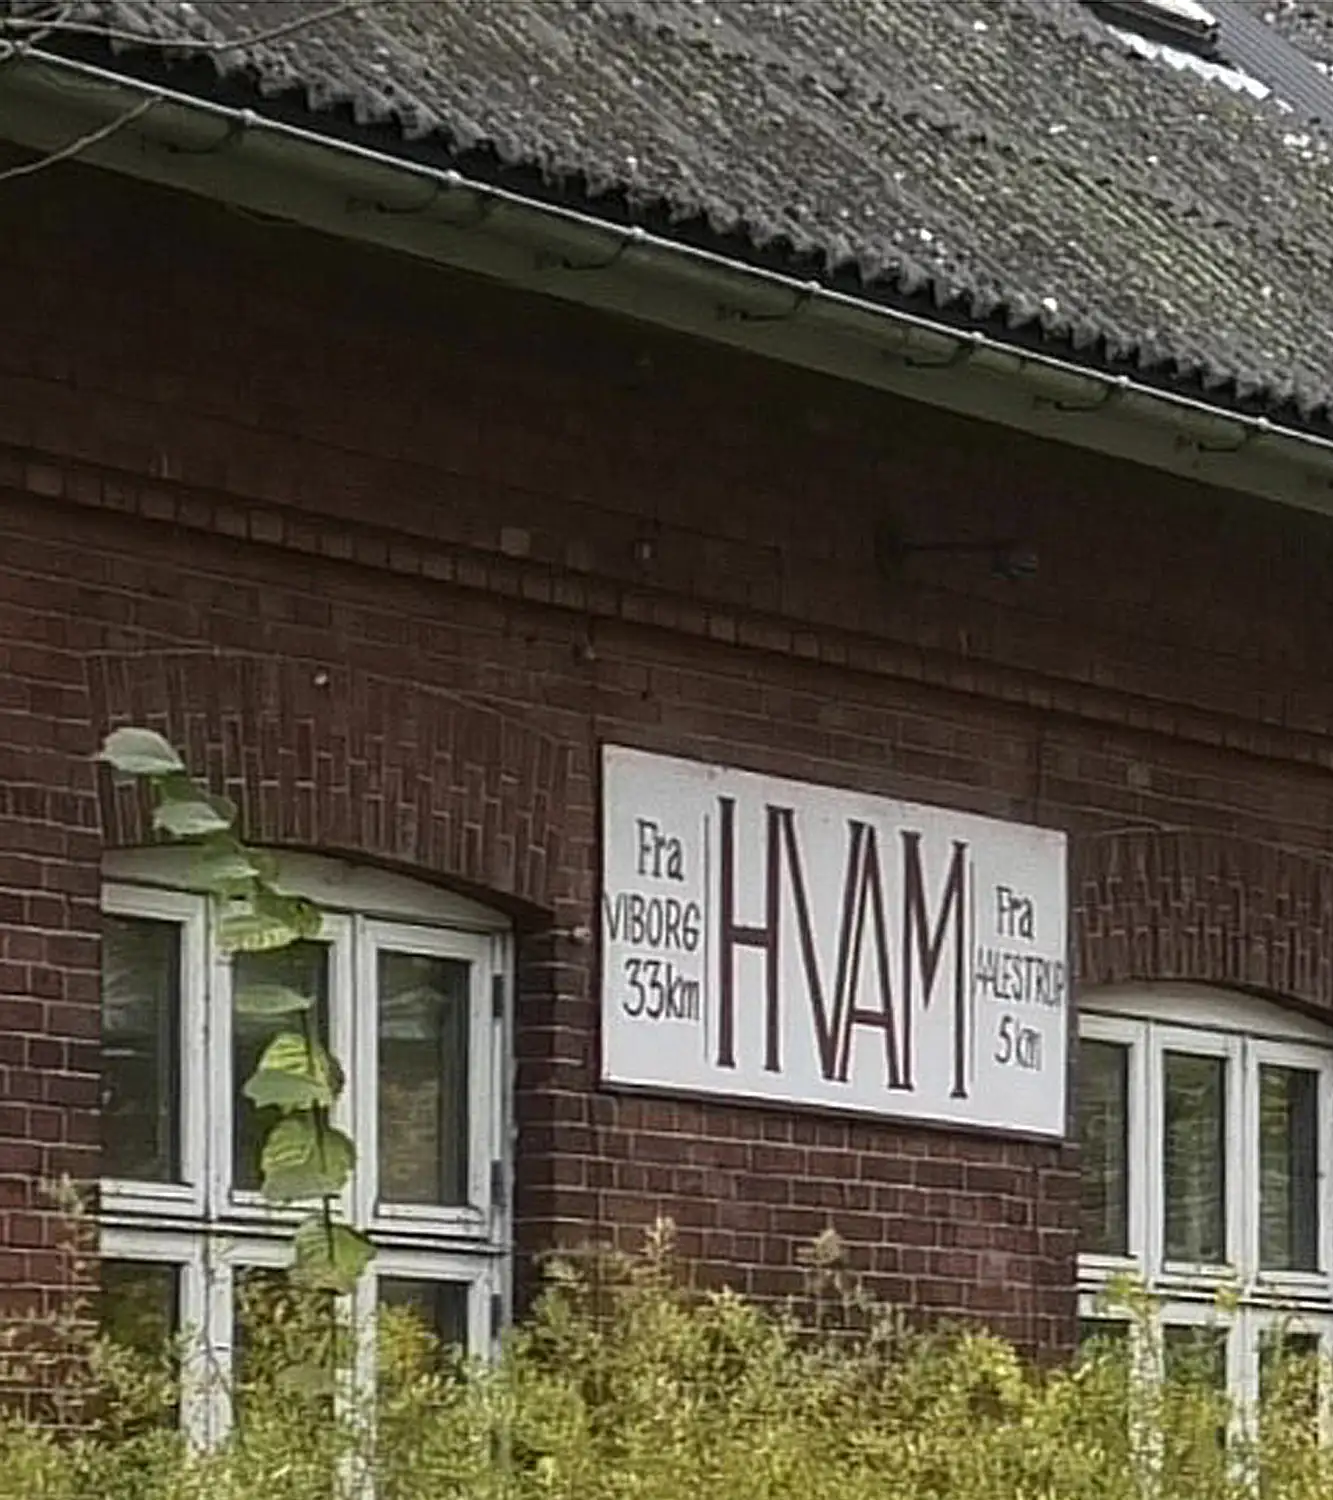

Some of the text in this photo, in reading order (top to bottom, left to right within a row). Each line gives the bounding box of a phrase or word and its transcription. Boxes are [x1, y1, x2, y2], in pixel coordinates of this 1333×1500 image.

[636, 818, 684, 881] Fra
[603, 893, 701, 951] VIBORG
[996, 886, 1034, 939] Fra
[717, 797, 968, 1099] HVAM
